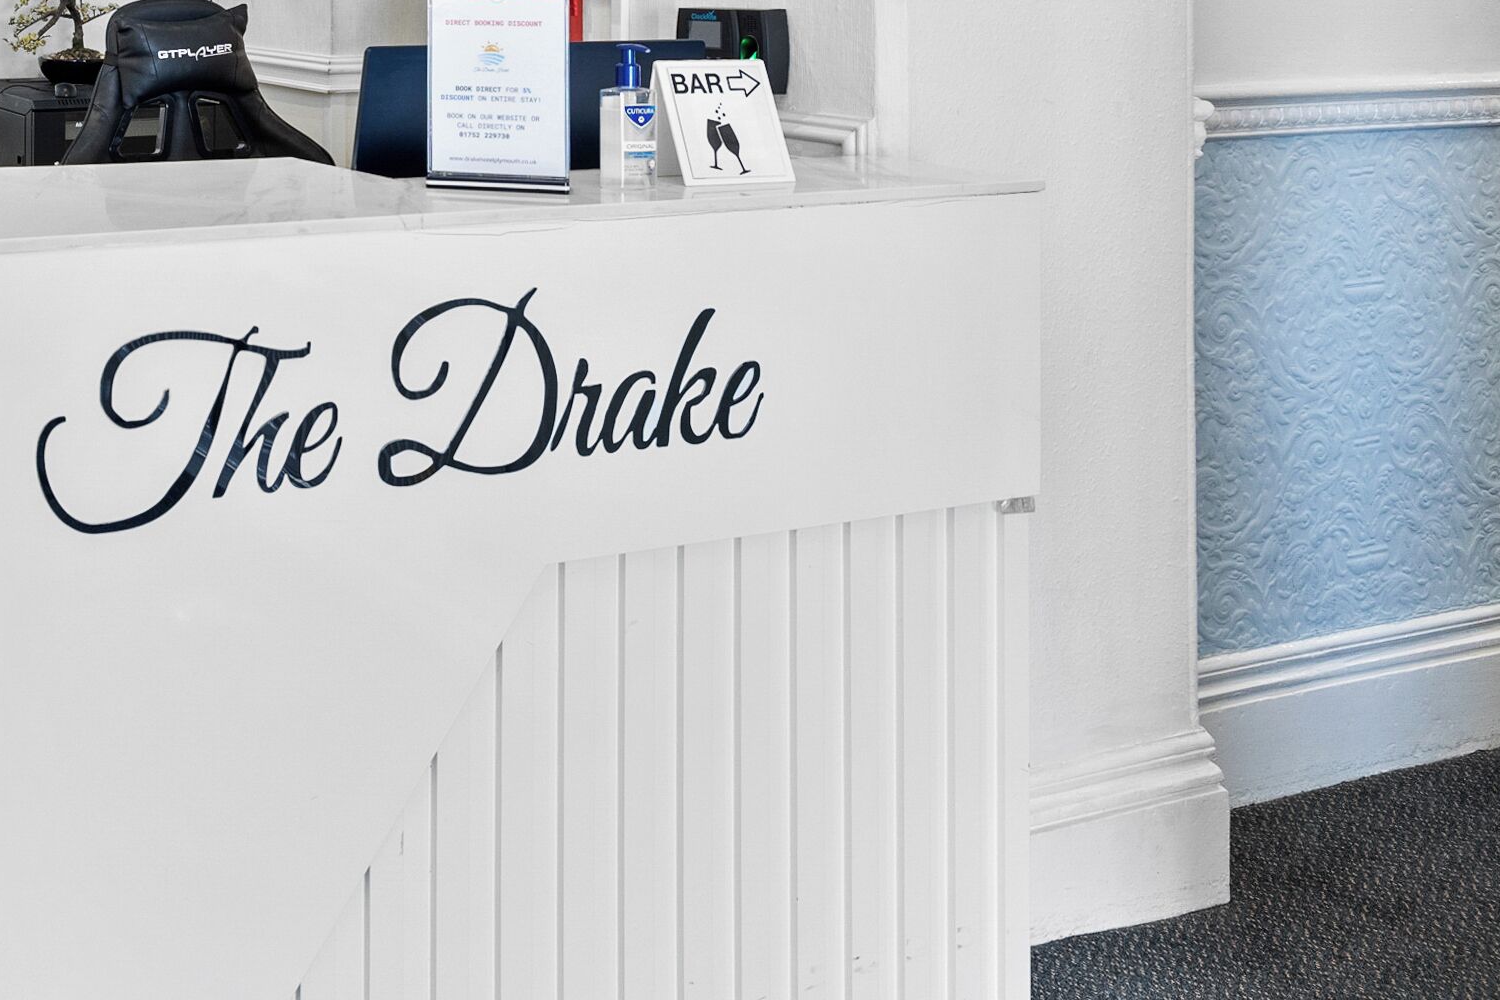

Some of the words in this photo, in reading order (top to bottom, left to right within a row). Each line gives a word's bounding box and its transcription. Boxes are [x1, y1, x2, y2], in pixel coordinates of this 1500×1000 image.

[157, 43, 233, 61] GTPLAYER
[671, 73, 724, 94] BAR
[36, 325, 343, 534] The
[377, 286, 765, 487] Drake
